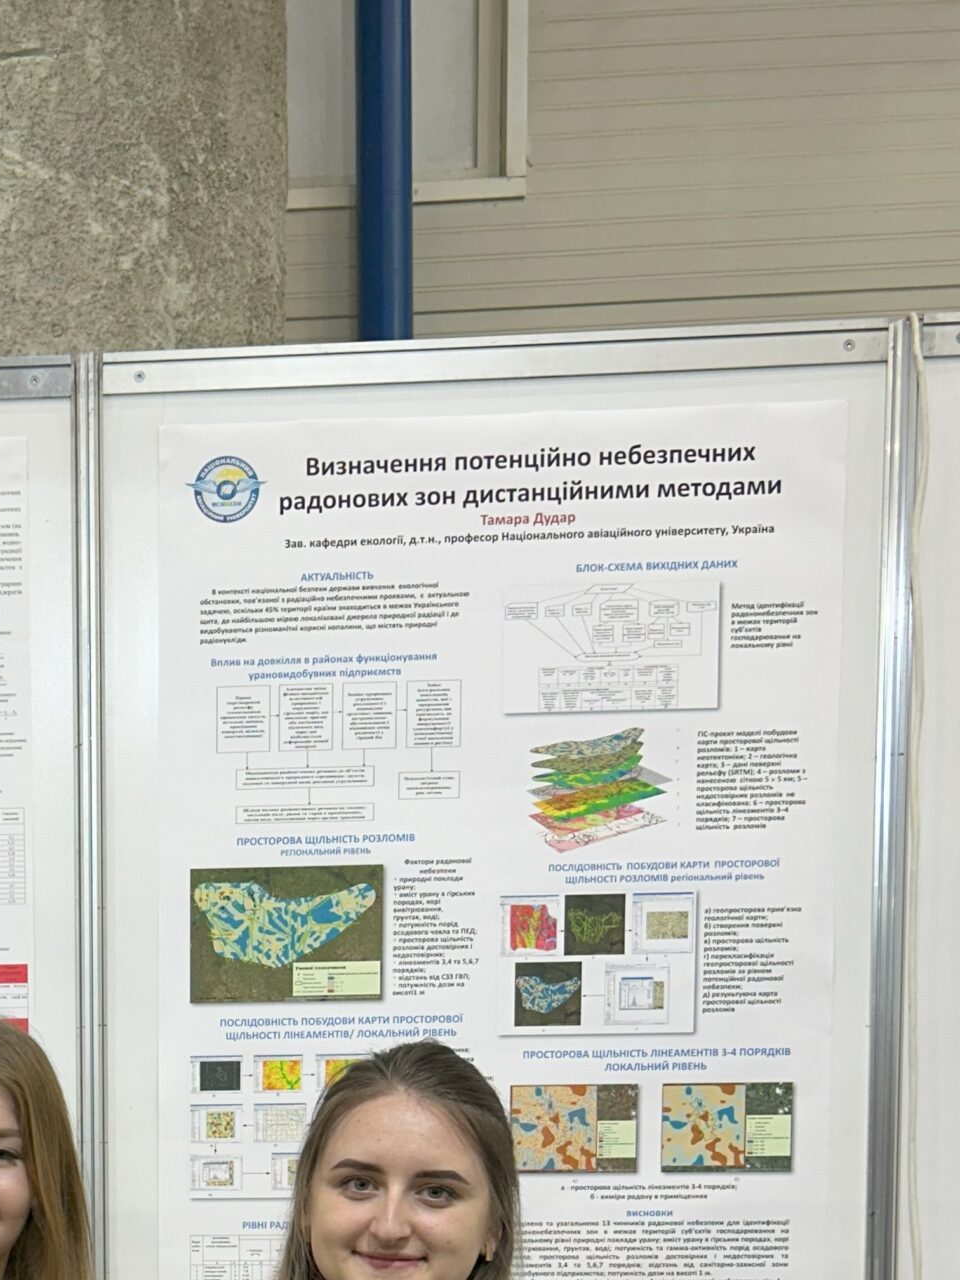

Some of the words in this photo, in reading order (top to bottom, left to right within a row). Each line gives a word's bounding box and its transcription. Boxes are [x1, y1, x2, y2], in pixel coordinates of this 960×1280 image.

[306, 457, 446, 475] Визначення
[455, 447, 591, 470] потенційно
[599, 445, 755, 464] небезпечних
[279, 492, 408, 513] радонових
[415, 490, 455, 505] зон
[462, 481, 649, 507] дистанційними
[657, 480, 781, 499] методами
[480, 514, 529, 526] Тамара
[532, 512, 575, 525] Дудар
[284, 539, 306, 548] Зав.
[309, 538, 357, 548] кафедри
[360, 535, 406, 545] екології,
[408, 536, 441, 545] д.т.н.,
[444, 533, 498, 544] професор
[501, 531, 584, 541] Національного
[587, 527, 652, 538] авіаційного
[654, 527, 728, 537] університету,
[731, 524, 774, 535] Україна
[575, 562, 643, 572] БЛОК-СХЕМА
[645, 561, 698, 570] ВИХІДНИХ
[700, 560, 737, 570] ДАНИХ
[300, 571, 373, 581] АКТУАЛЬНІСТЬ
[210, 658, 241, 666] Вплив
[257, 657, 301, 666] довкілля
[312, 654, 353, 665] районах
[355, 653, 437, 663] функціонування
[248, 669, 336, 680] урановидобувних
[339, 668, 401, 677] підприємств
[236, 836, 302, 845] ПРОСТОРОВА
[304, 834, 360, 844] ЩІЛЬНІСТЬ
[362, 833, 415, 842] РОЗЛОМІВ
[548, 862, 622, 872] ПОСЛІДОВНІСТЬ
[626, 861, 677, 870] ПОБУДОВИ
[679, 860, 710, 868] КАРТИ
[714, 858, 780, 867] ПРОСТОРОВОЇ
[565, 875, 617, 884] ЩІЛЬНОСТІ
[619, 873, 668, 882] РОЗЛОМІВ
[670, 872, 732, 882] регіональний
[734, 872, 764, 881] рівень
[219, 1017, 298, 1027] ПОСЛІДОВНІСТЬ
[300, 1016, 355, 1026] ПОБУДОВИ
[357, 1016, 389, 1024] КАРТИ
[392, 1014, 462, 1023] ПРОСТОРОВОЇ
[225, 1031, 280, 1041] ЩІЛЬНОСТІ
[356, 1027, 419, 1037] ЛОКАЛЬНИЙ
[422, 1028, 456, 1038] РІВЕНЬ
[522, 1050, 589, 1058] ПРОСТОРОВА
[591, 1049, 648, 1058] ЩІЛЬНІСТЬ
[649, 1048, 718, 1057] ЛІНЕАМЕНТІВ
[721, 1047, 736, 1056] 3-4
[739, 1047, 791, 1056] ПОРЯДКІВ
[604, 1060, 669, 1071] ЛОКАЛЬНИЙ
[671, 1062, 707, 1070] РІВЕНЬ
[626, 1209, 674, 1218] ВИСНОВКИ
[242, 1221, 267, 1229] РІВНІ
[270, 1221, 289, 1231] РАД
